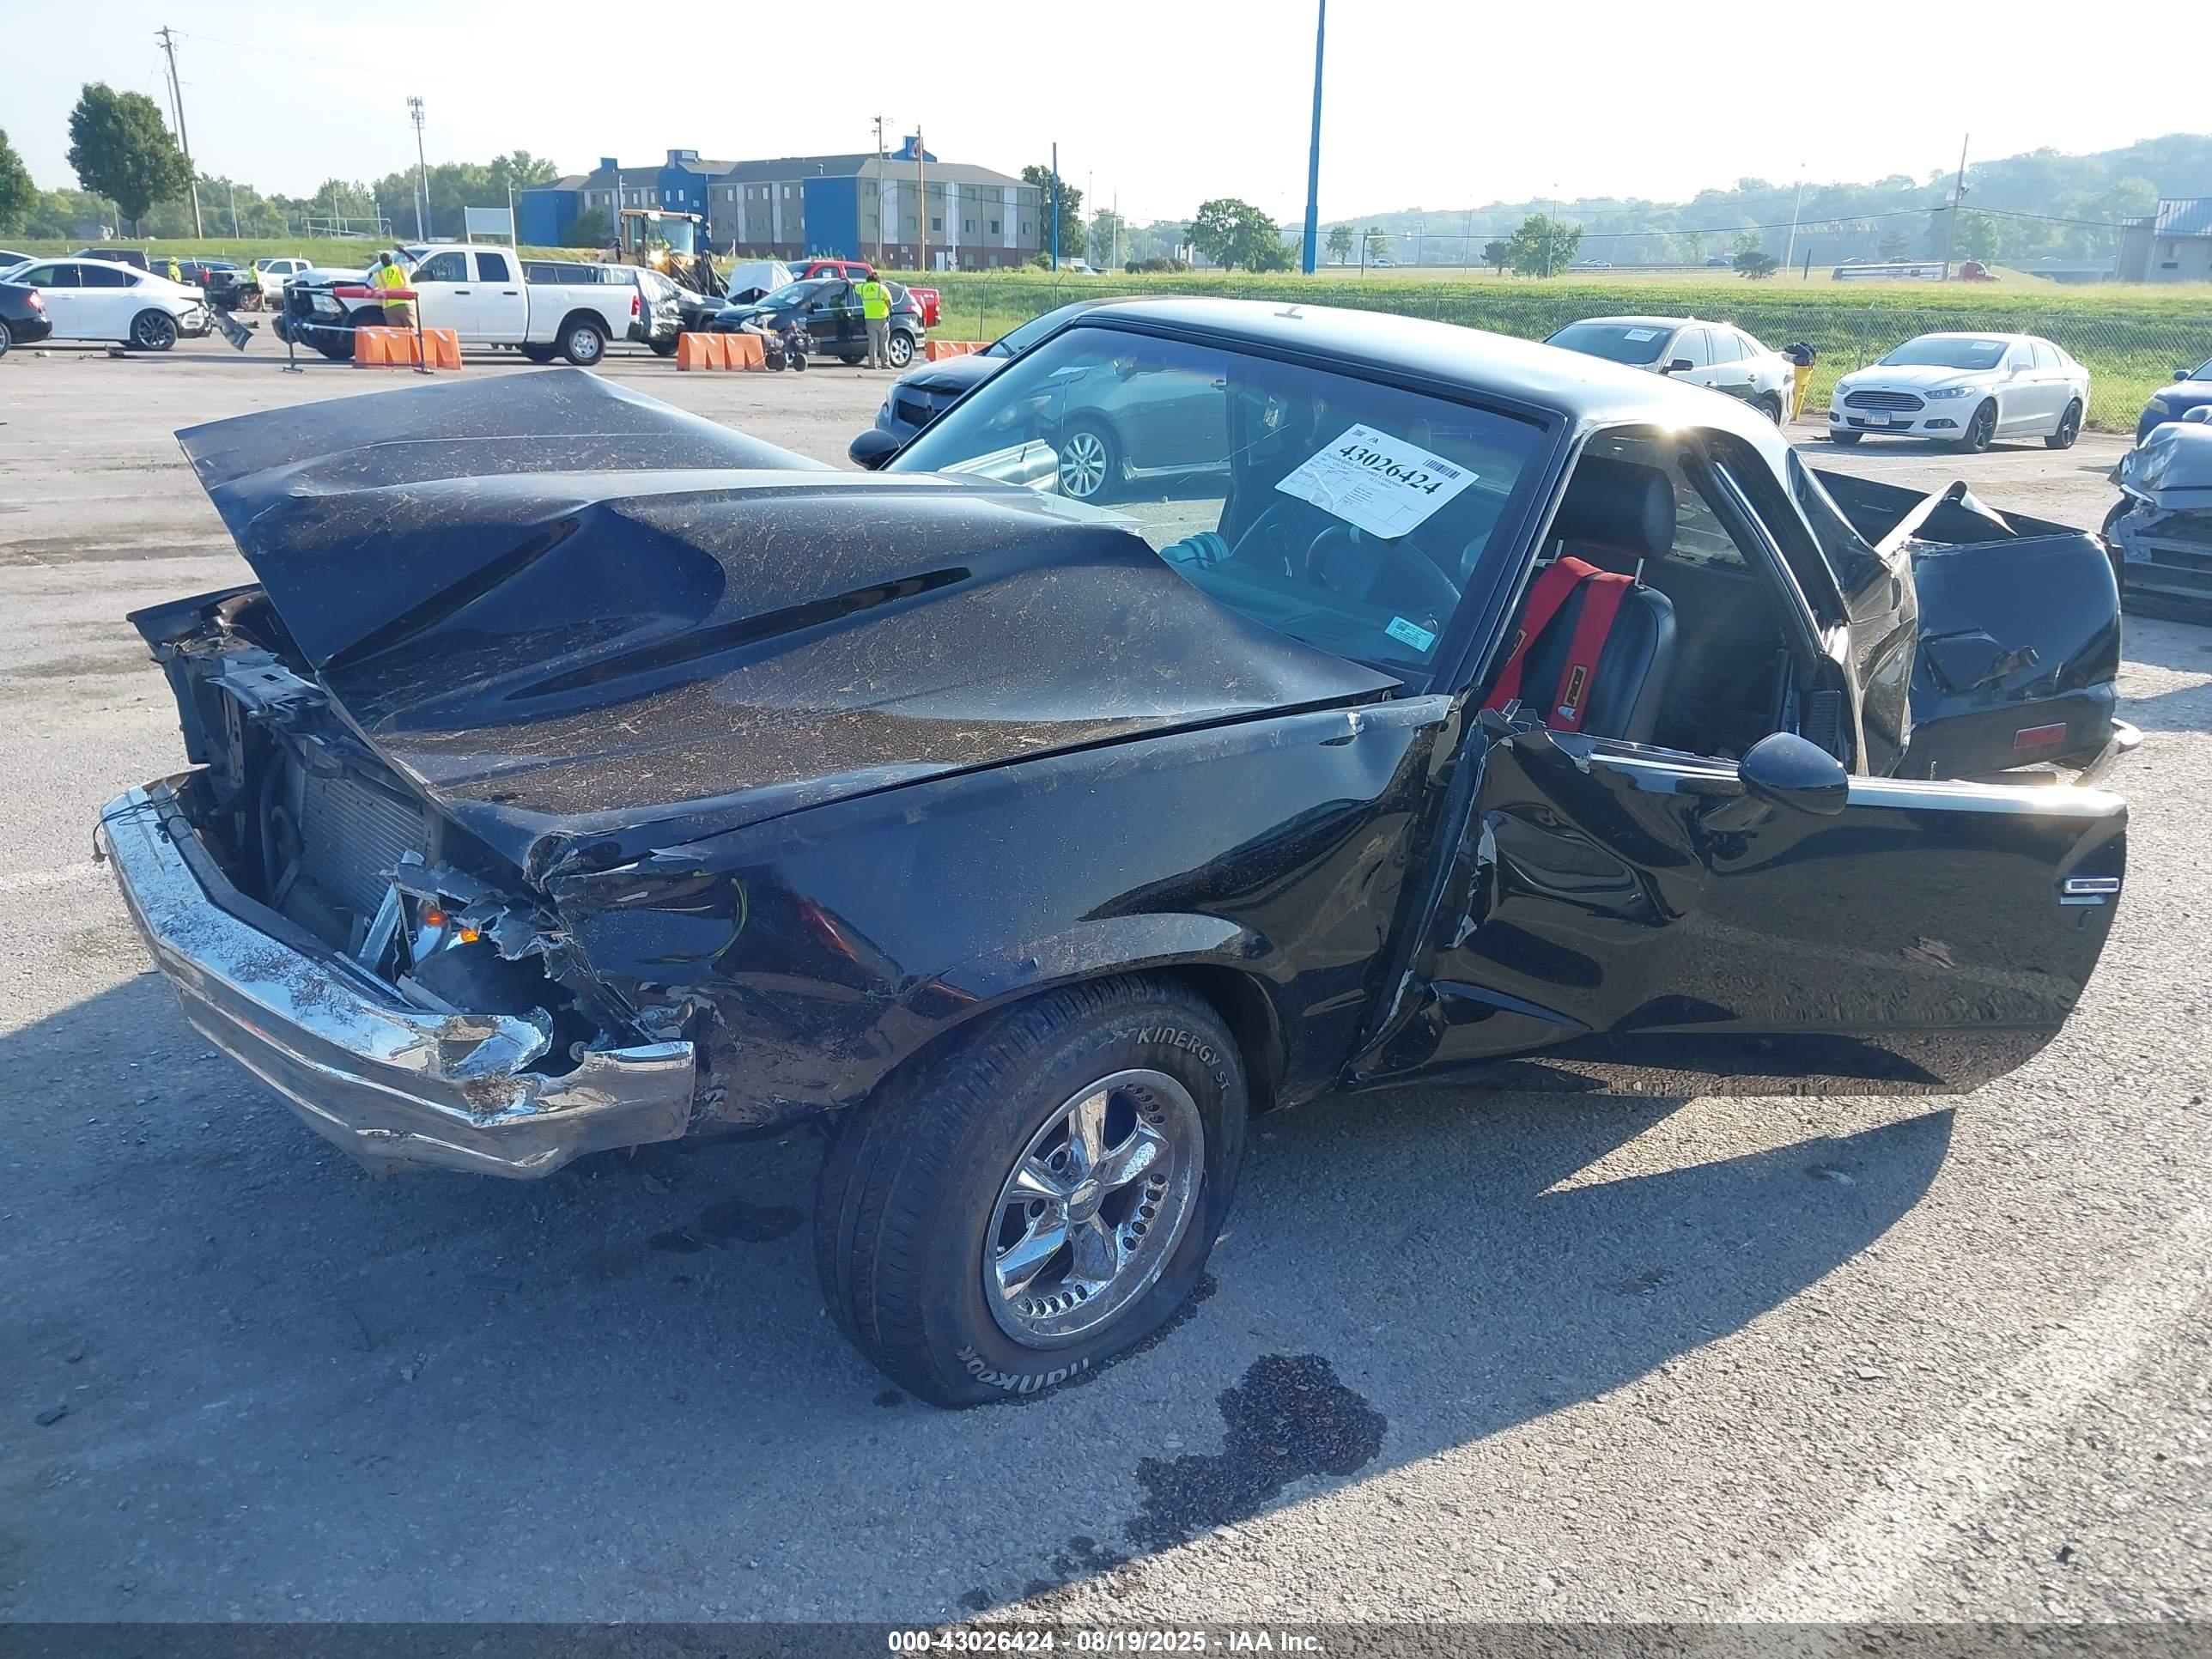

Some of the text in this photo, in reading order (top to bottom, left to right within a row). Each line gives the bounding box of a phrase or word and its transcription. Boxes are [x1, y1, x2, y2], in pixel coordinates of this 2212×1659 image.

[1340, 445, 1443, 495] 43026424
[1137, 1027, 1231, 1090] KINERGY ST
